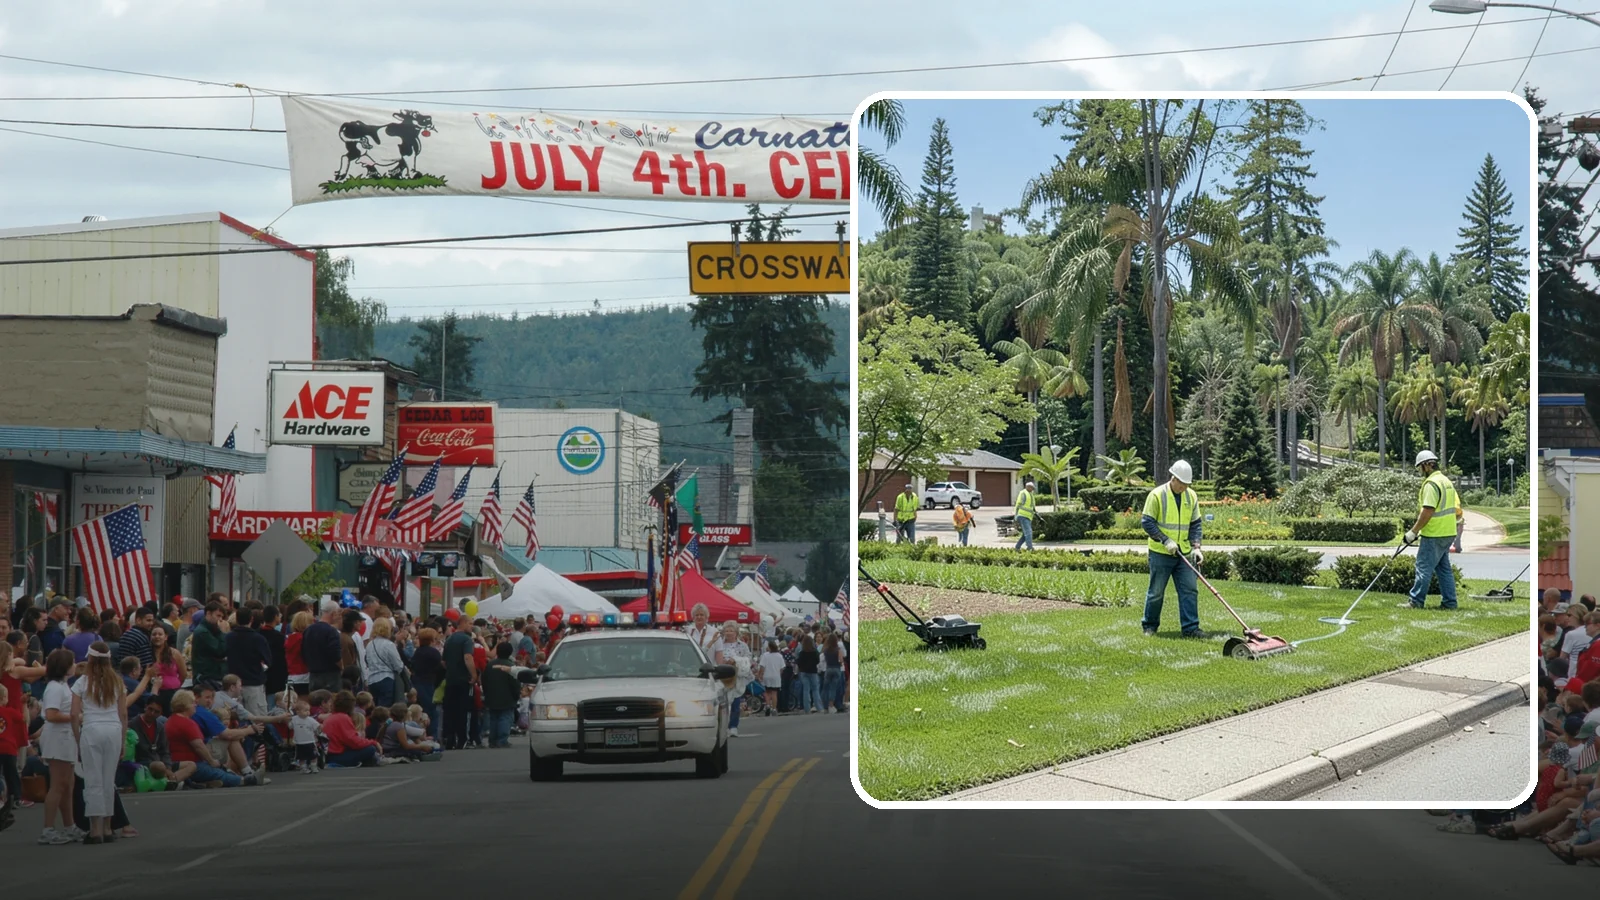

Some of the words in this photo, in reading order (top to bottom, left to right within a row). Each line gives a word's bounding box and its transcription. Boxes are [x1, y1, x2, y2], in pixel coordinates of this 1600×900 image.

[481, 141, 605, 192] JULY
[632, 150, 746, 198] 4th.
[697, 254, 850, 280] CROSSWA
[283, 380, 373, 420] ACE
[405, 409, 452, 422] CEDAR
[283, 421, 370, 436] Hardware
[416, 427, 477, 447] Coca-Cola
[96, 485, 124, 494] Vincent
[126, 485, 136, 495] de
[137, 485, 155, 495] Paul
[688, 526, 741, 535] CRNATION
[699, 535, 729, 543] GLASS
